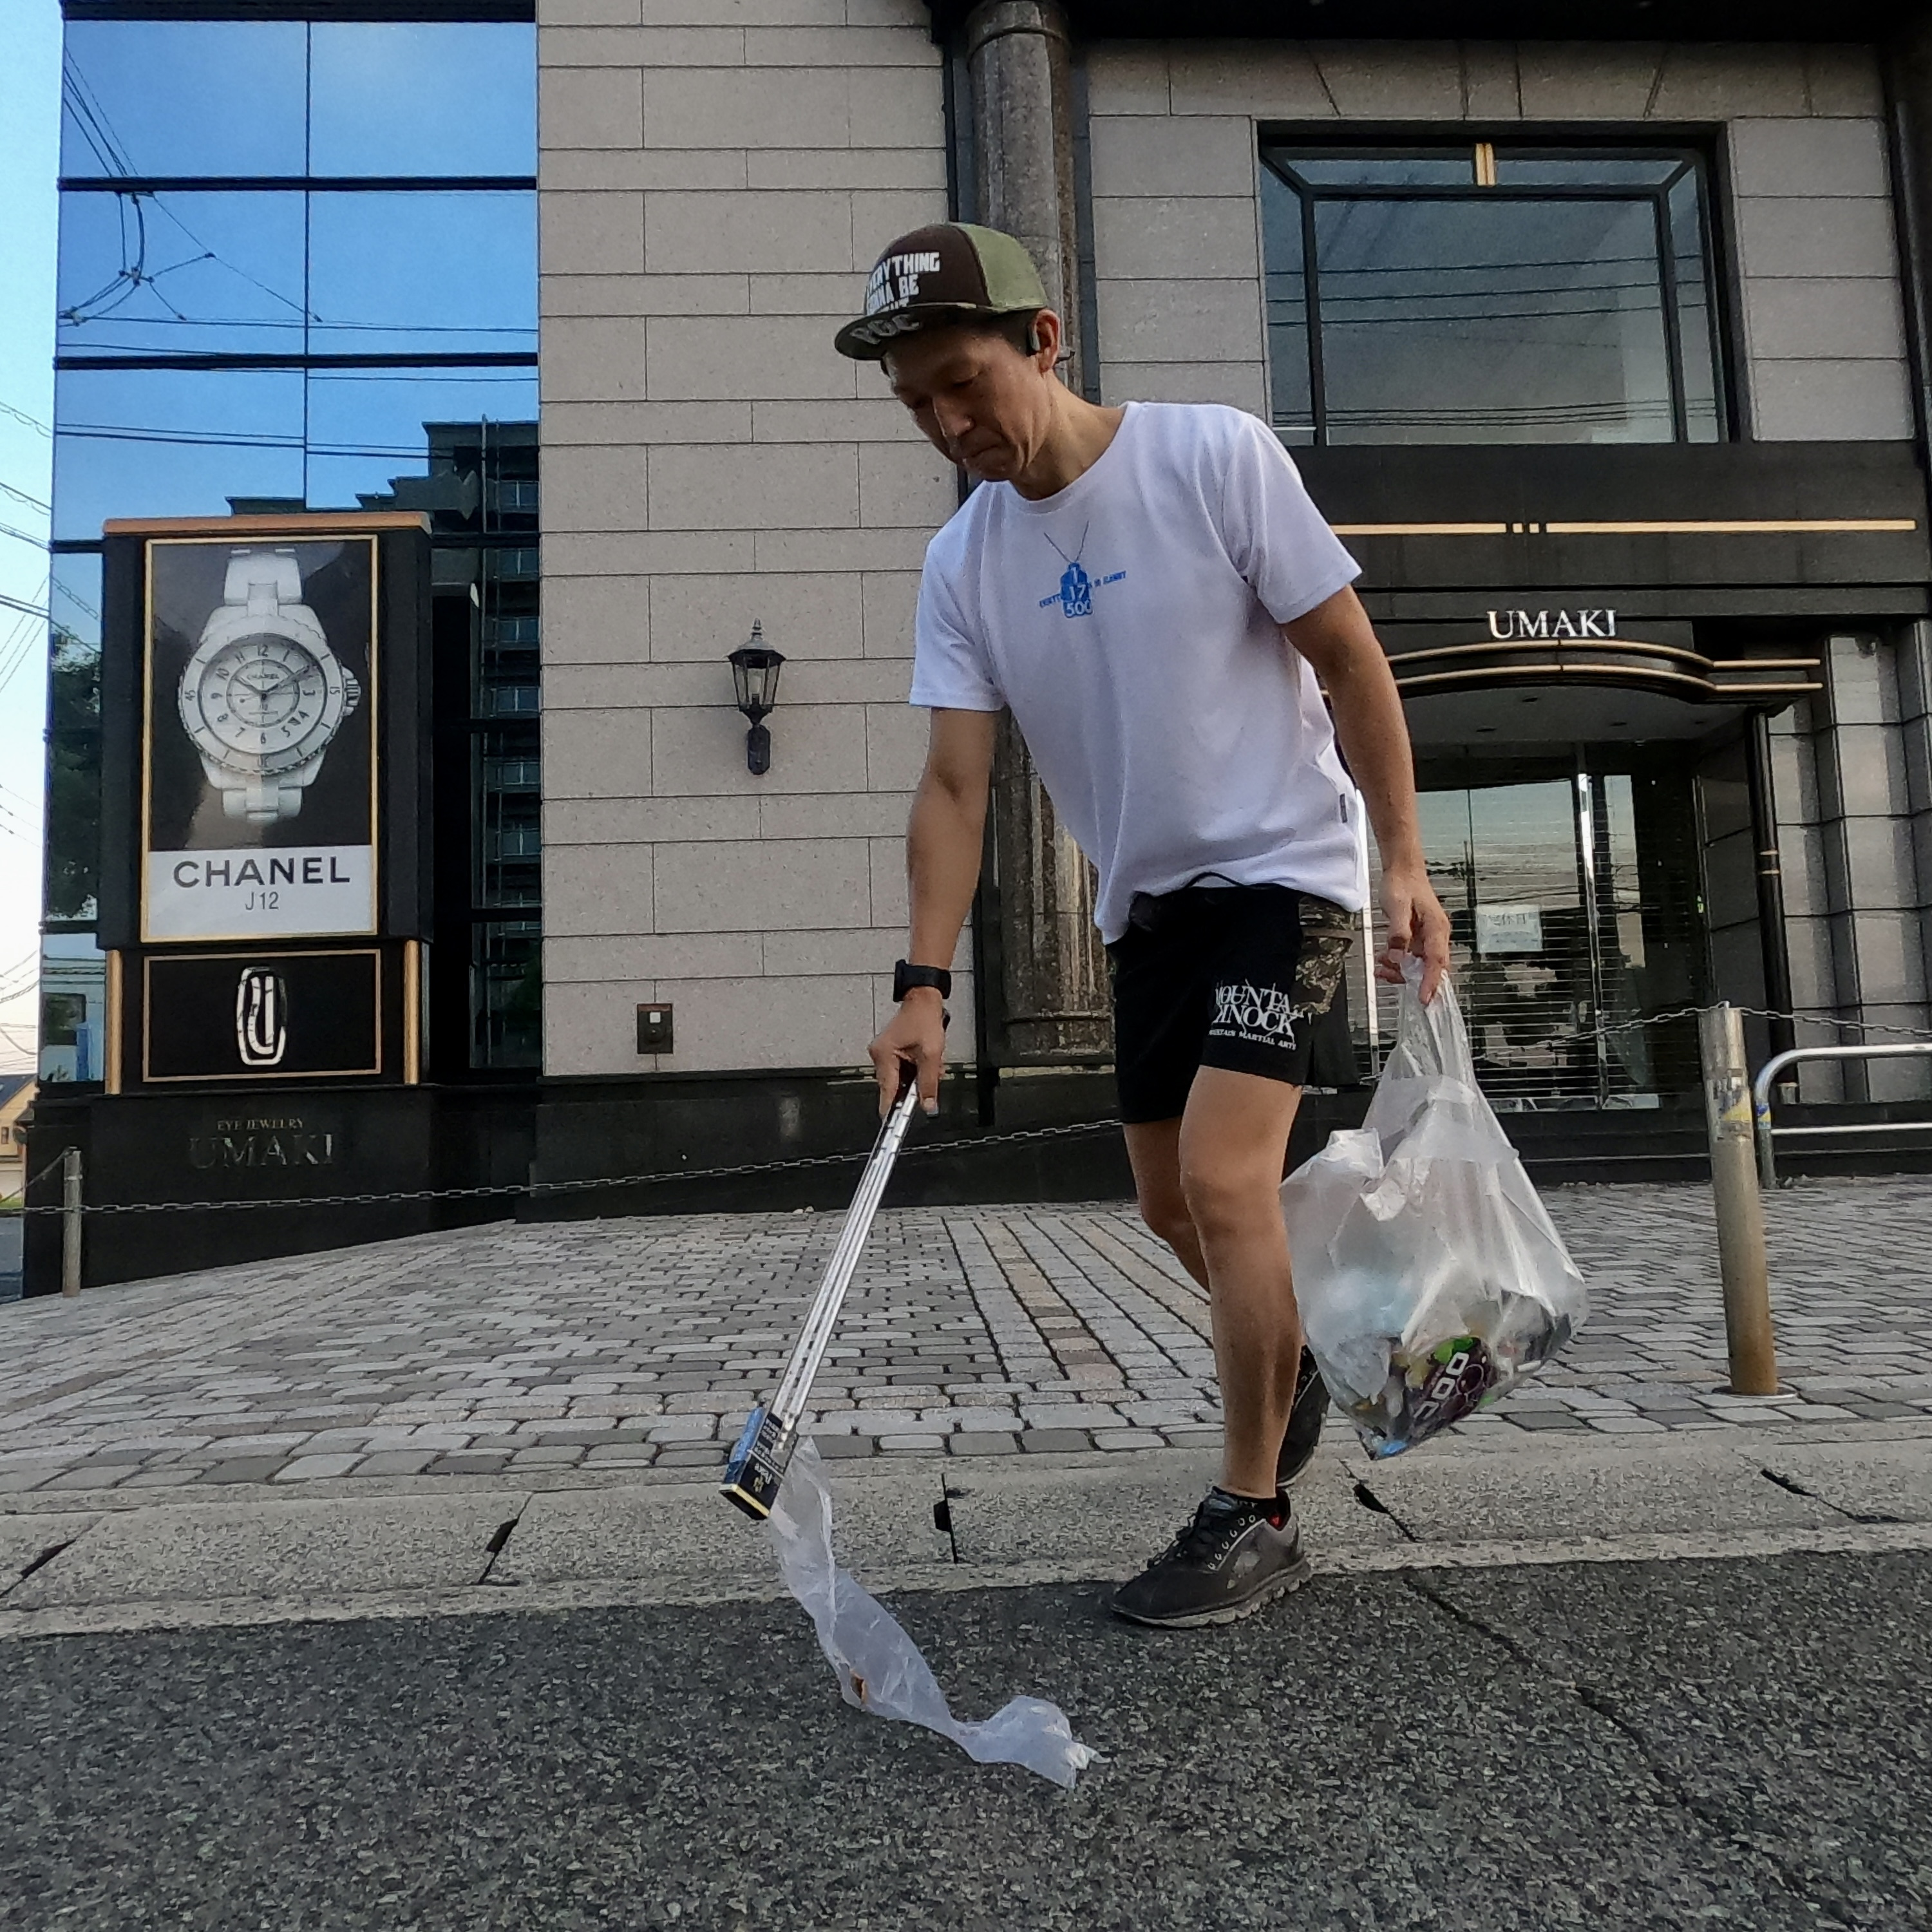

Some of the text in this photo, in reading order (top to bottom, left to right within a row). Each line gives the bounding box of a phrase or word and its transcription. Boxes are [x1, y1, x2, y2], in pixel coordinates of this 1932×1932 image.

[867, 252, 940, 298] VERYTHING
[898, 274, 920, 299] BE
[1070, 583, 1086, 601] 17
[1066, 598, 1094, 618] 500
[1486, 609, 1618, 639] UMAKI
[258, 645, 269, 657] 12
[260, 732, 267, 744] 6
[173, 856, 350, 888] CHANEL
[245, 891, 279, 910] J12
[1278, 1039, 1297, 1051] ARTS
[218, 1118, 303, 1132] EYE JEWELRY
[190, 1133, 334, 1169] UMAKI
